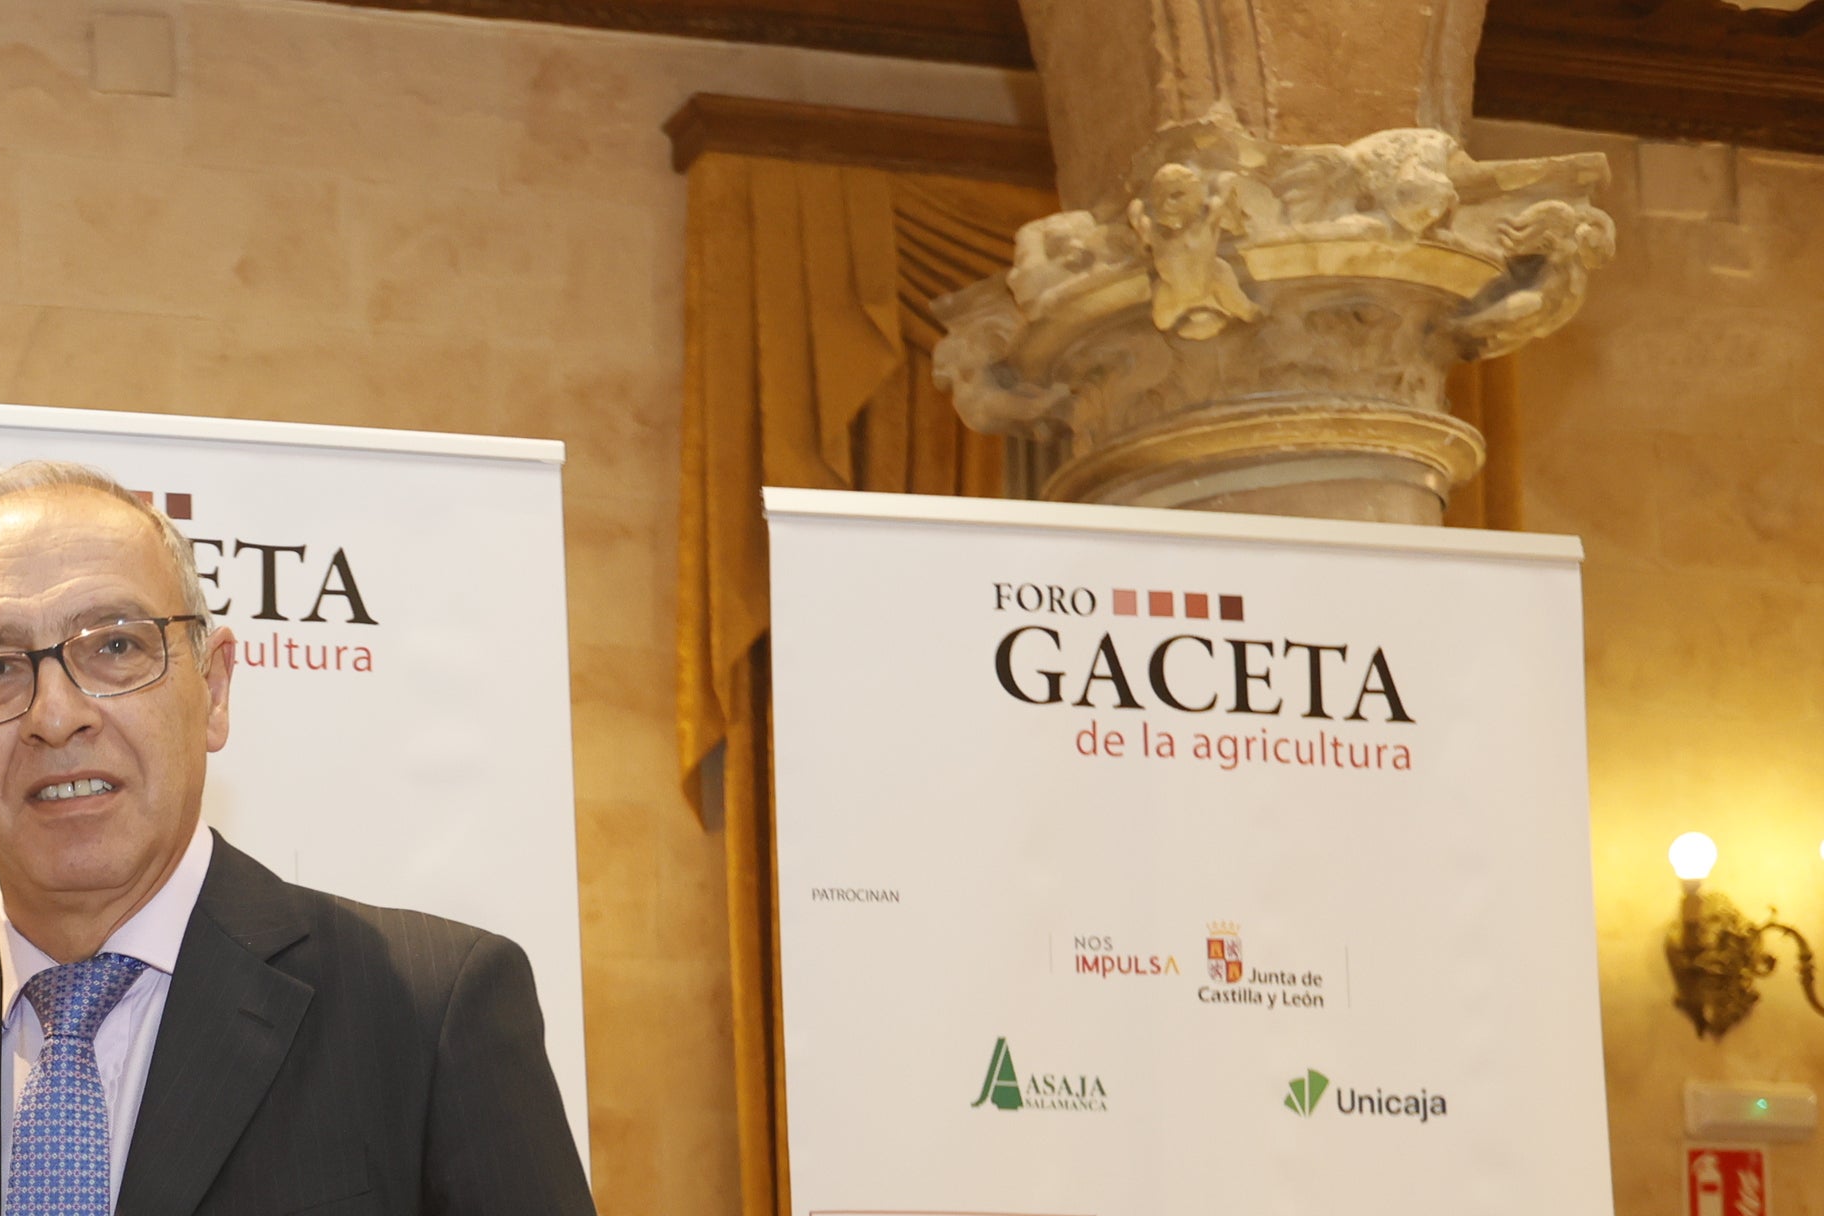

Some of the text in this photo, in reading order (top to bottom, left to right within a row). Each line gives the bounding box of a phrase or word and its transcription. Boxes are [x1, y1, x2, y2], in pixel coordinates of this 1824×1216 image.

[188, 538, 379, 625] ETA
[993, 583, 1097, 617] FORO
[232, 633, 374, 673] ultura
[994, 625, 1417, 724] GACETA
[1075, 719, 1412, 771] de la agricultura
[811, 887, 900, 903] PATROCINAN
[1074, 935, 1114, 952] NOS
[1248, 967, 1323, 988] Junta de
[1197, 986, 1325, 1010] Castilla y León
[1026, 1074, 1107, 1098] ASAJA
[1026, 1098, 1107, 1112] SALAMANCA
[1336, 1087, 1448, 1124] Unicaja
